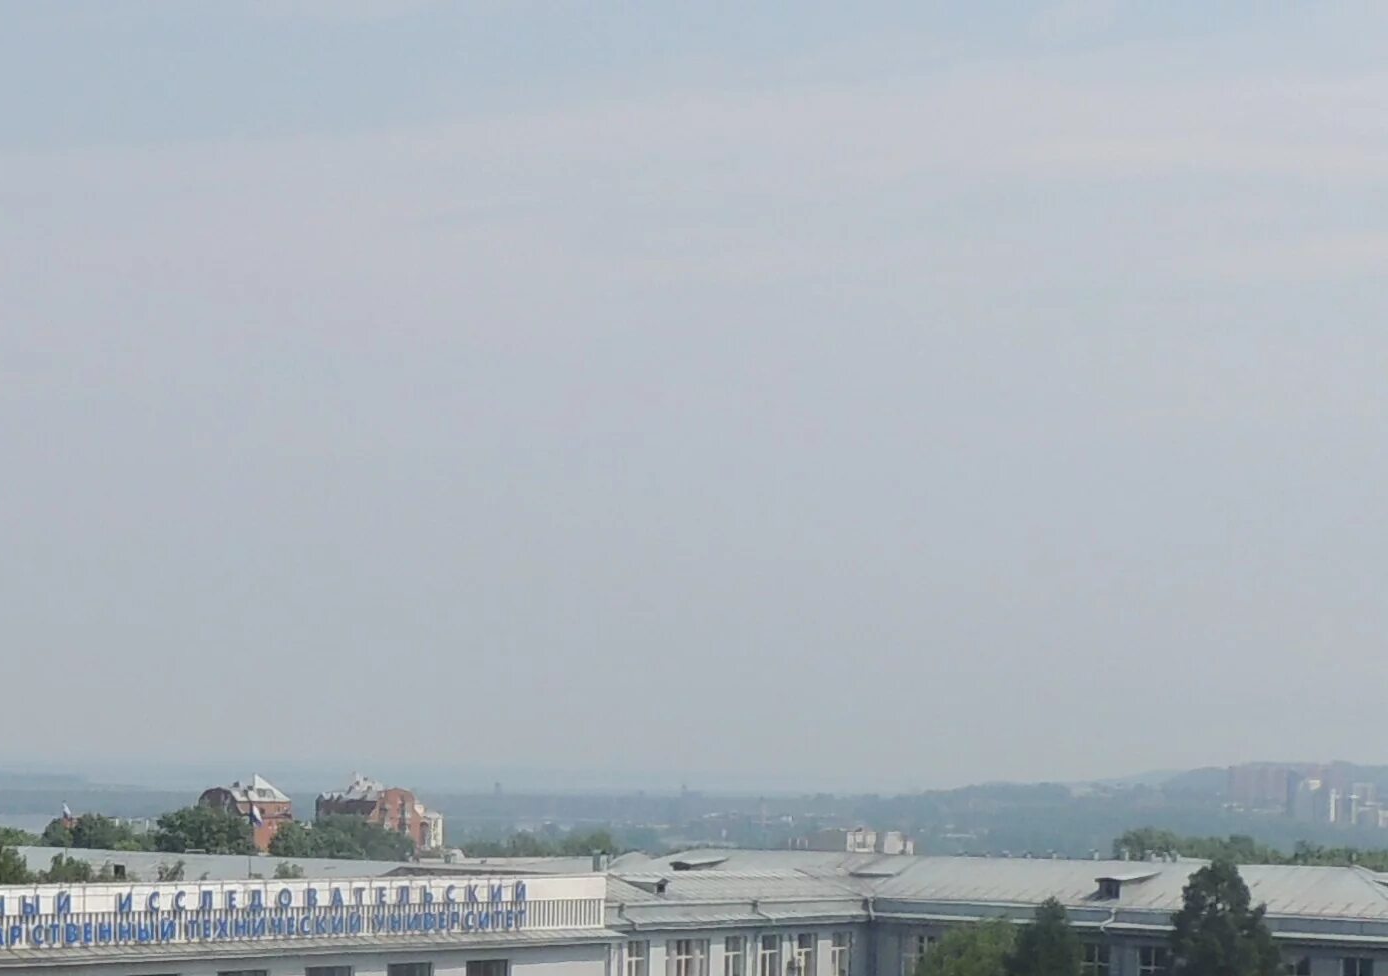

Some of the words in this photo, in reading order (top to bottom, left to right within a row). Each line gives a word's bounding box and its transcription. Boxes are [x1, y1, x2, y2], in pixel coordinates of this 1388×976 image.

[117, 880, 527, 913] ИССЛЕДОВАТЕЛЬСКИЙ
[187, 912, 362, 939] ТЕХНИЧЕСКИЙ
[374, 909, 527, 933] УНИВЕРСИТЕТ
